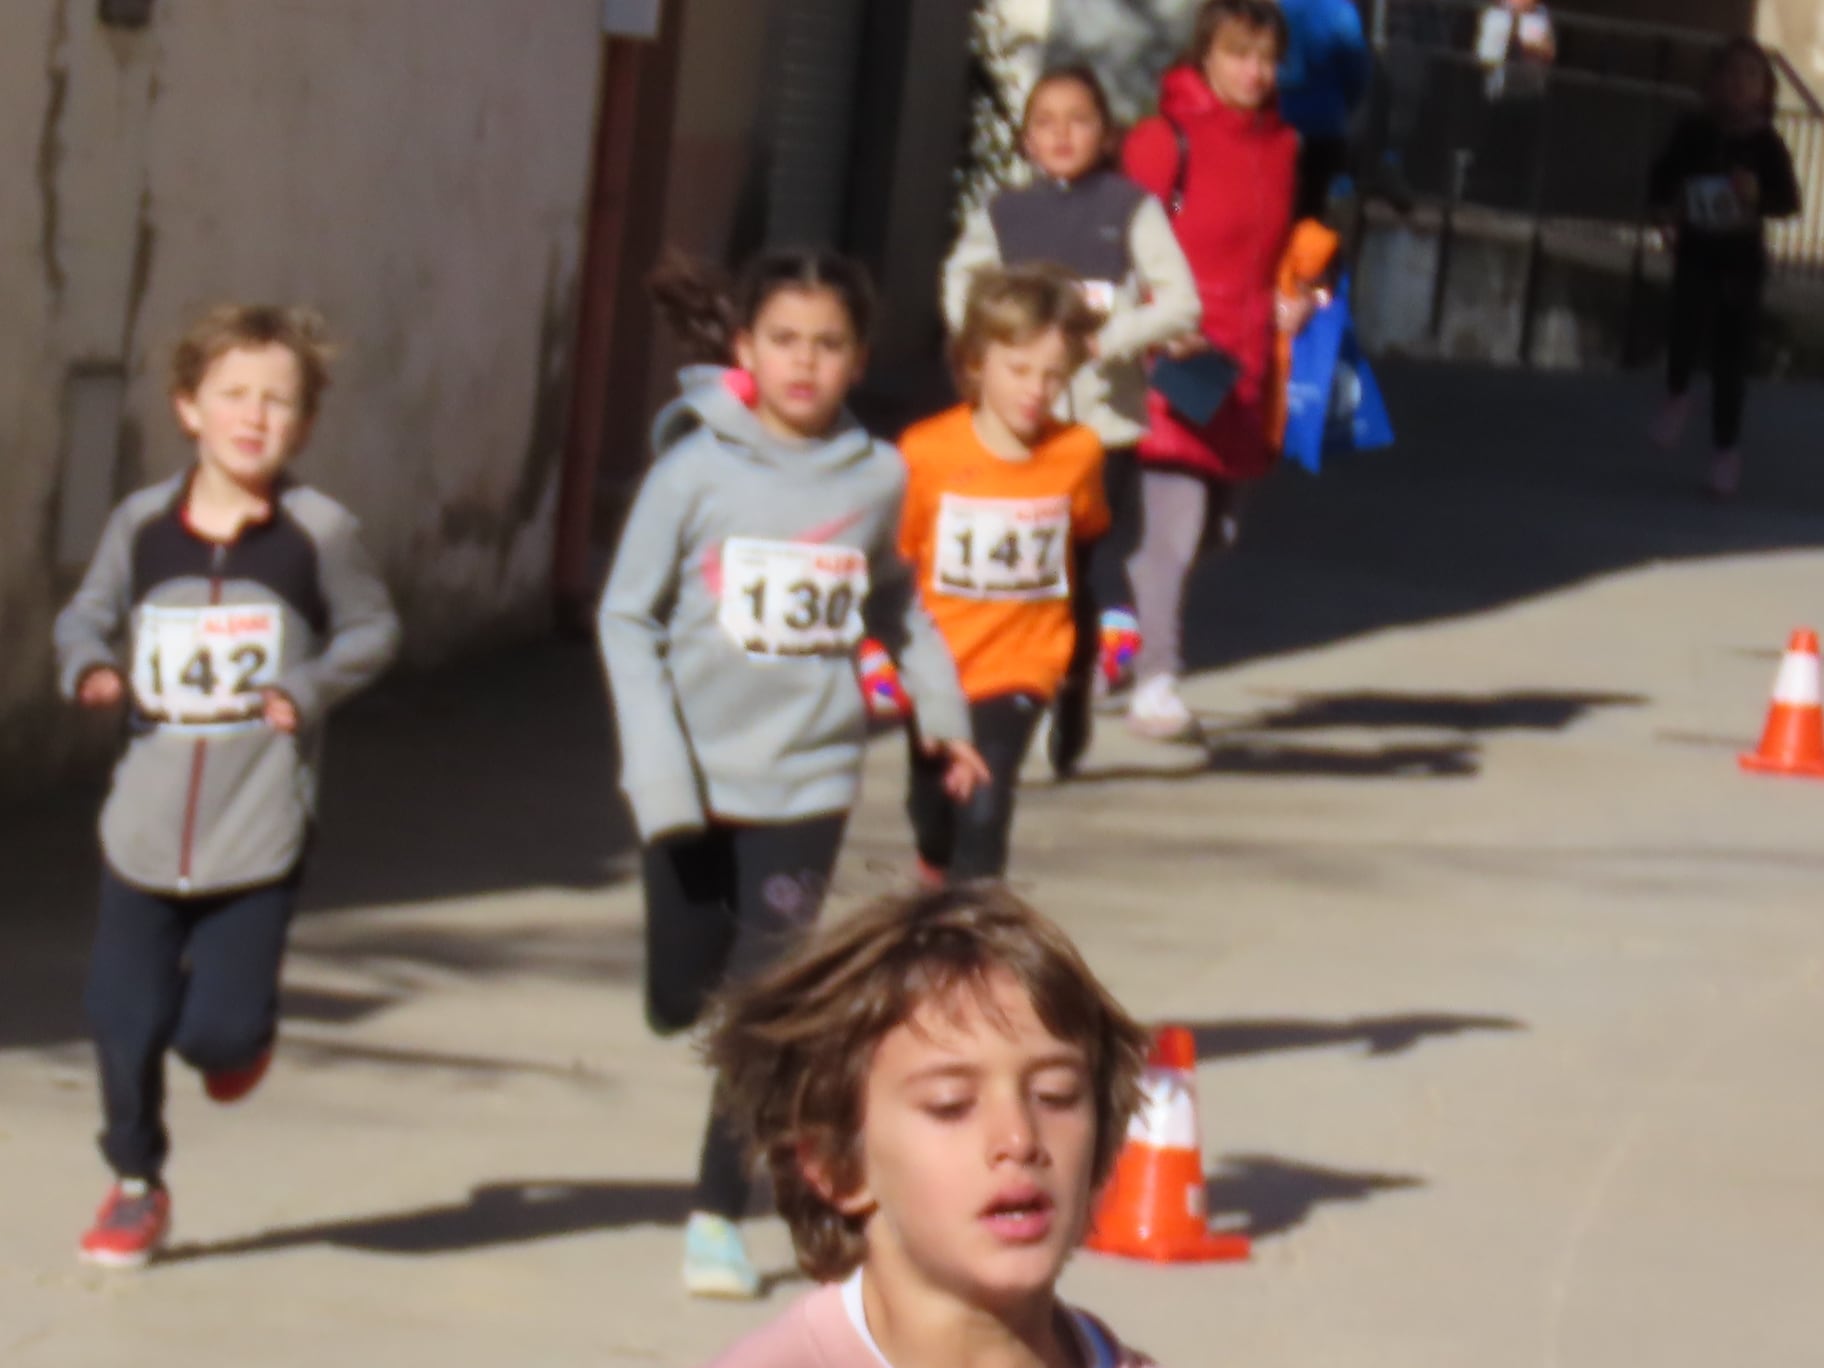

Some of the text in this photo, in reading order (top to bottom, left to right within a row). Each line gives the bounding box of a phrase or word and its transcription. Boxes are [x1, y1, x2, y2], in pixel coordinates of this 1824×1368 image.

[954, 528, 1057, 569] 147
[743, 577, 852, 631] 130
[149, 644, 267, 696] 142
